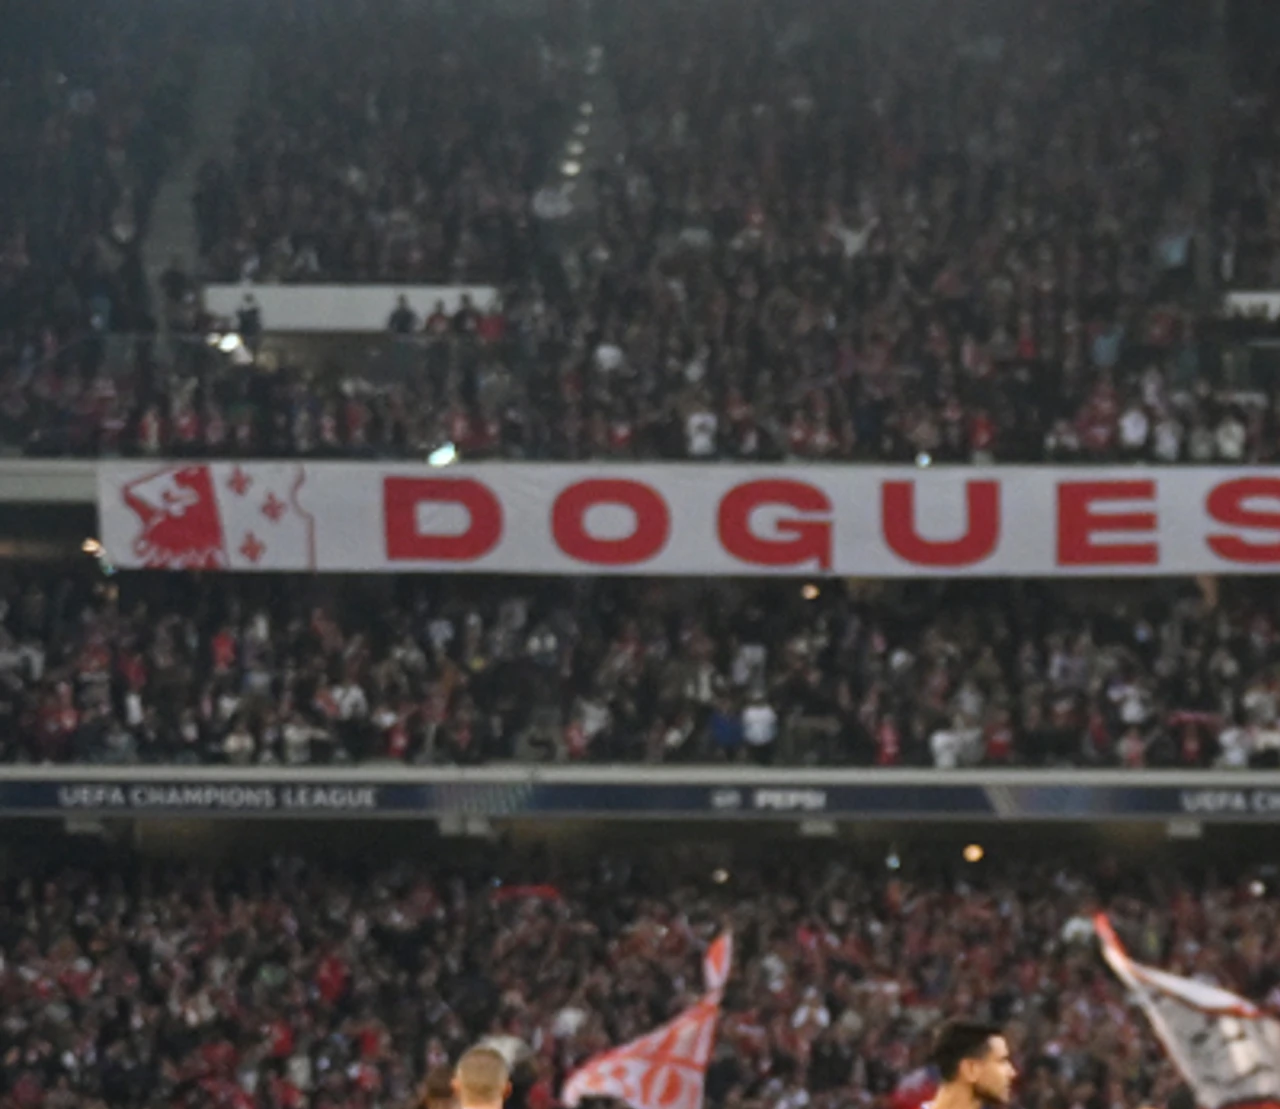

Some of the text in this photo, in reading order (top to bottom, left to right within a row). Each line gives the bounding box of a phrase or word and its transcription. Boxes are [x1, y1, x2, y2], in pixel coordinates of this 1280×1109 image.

[57, 785, 377, 808] UEFA CHAMPIONS LEAGUE
[1180, 790, 1246, 812] UEFA
